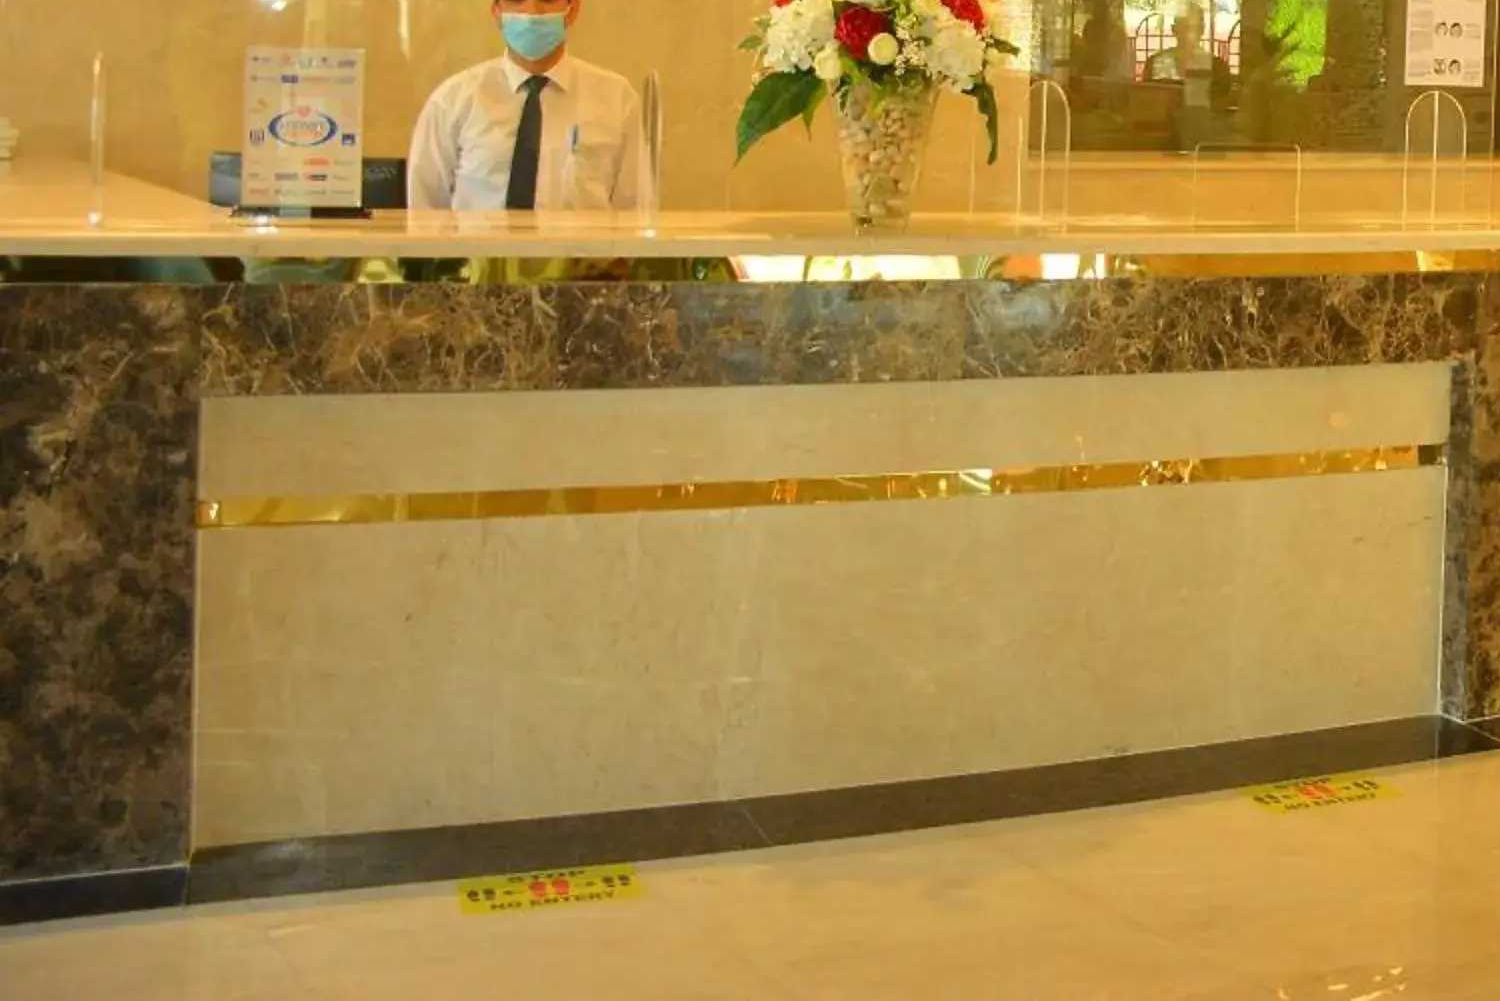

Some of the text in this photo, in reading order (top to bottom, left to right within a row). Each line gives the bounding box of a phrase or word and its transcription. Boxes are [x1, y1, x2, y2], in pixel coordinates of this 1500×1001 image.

[1273, 777, 1331, 790] STOP
[508, 870, 585, 883] STOP
[490, 901, 522, 911] NO
